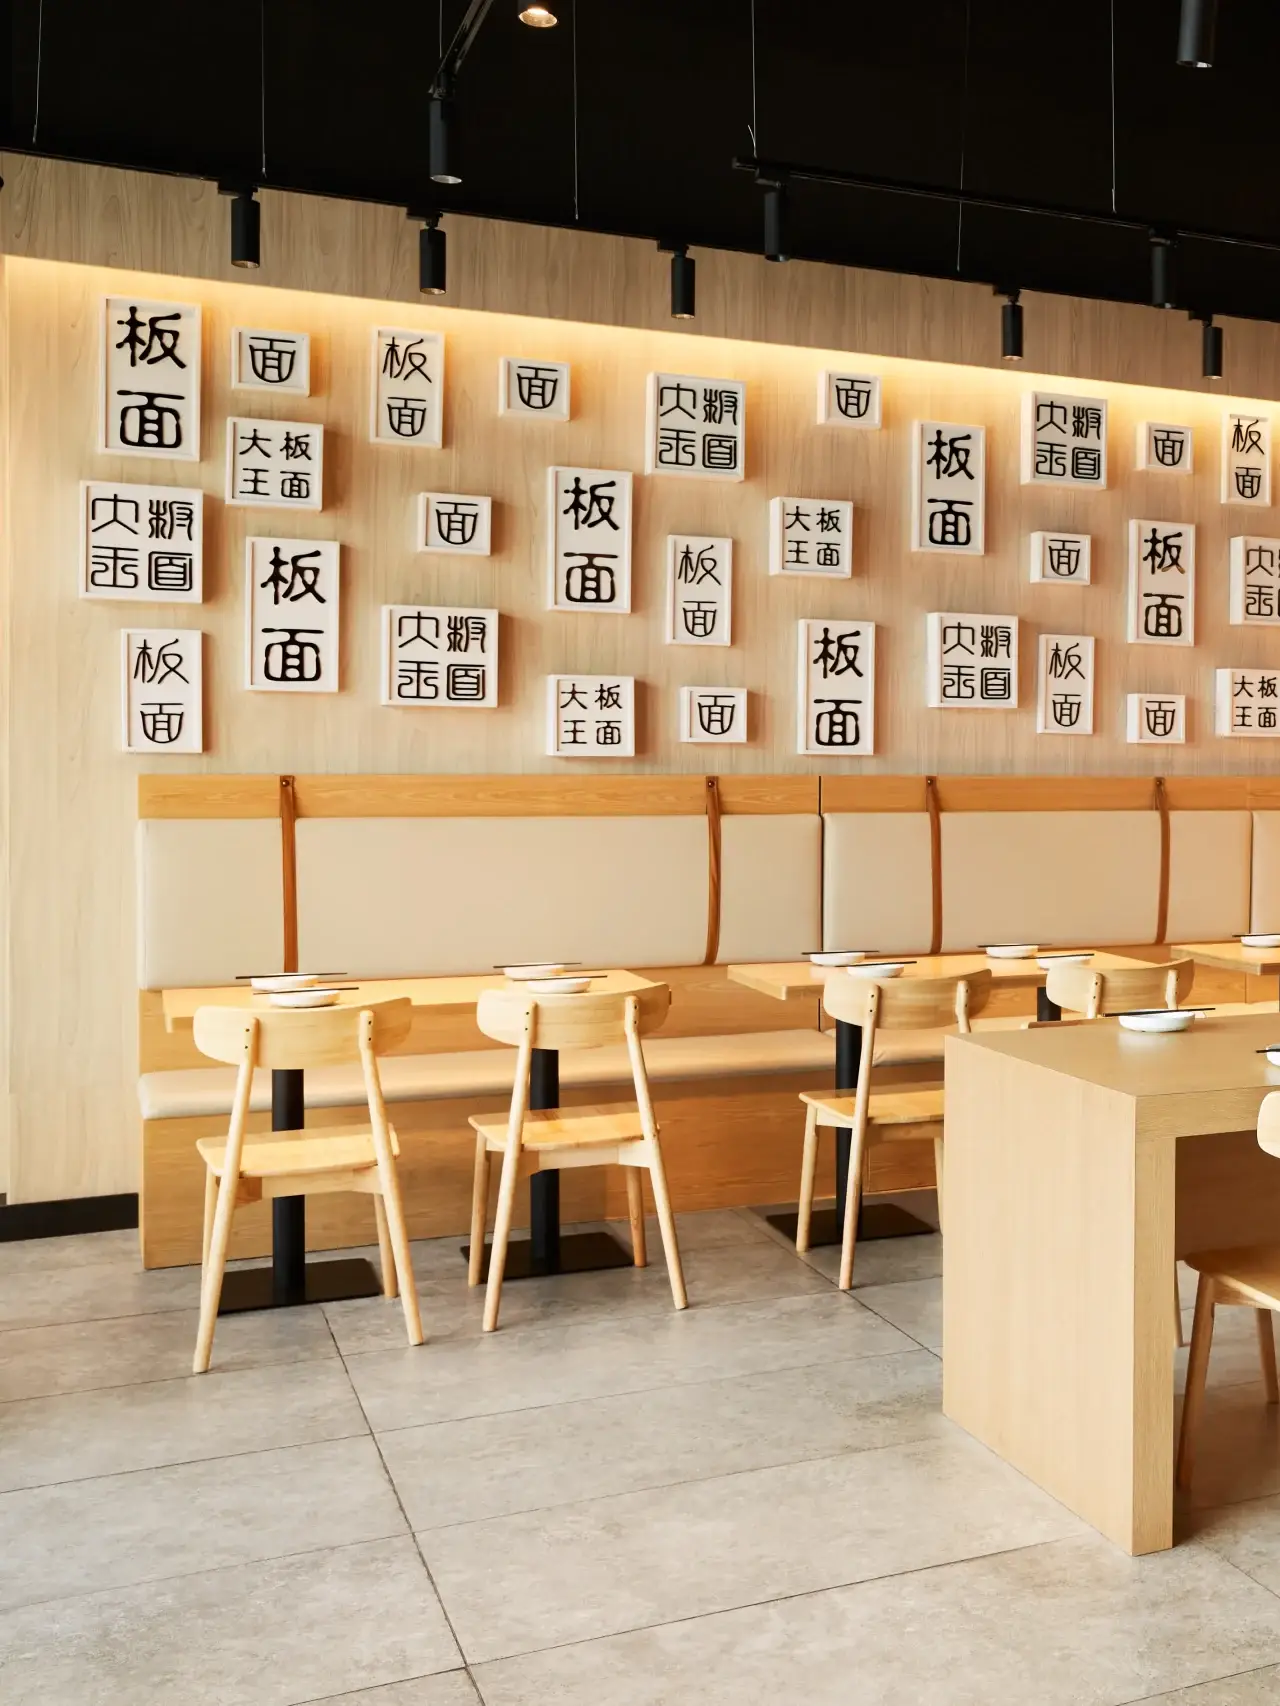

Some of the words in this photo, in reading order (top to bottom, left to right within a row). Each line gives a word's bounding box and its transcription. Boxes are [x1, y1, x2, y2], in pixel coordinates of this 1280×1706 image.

[116, 306, 186, 448] 板面
[249, 337, 296, 383] 面
[383, 337, 431, 437] 板面
[517, 366, 558, 409] 面
[836, 379, 871, 418] 面
[927, 430, 974, 545] 板面
[1154, 430, 1184, 466] 面
[1232, 419, 1264, 498] 板面
[436, 502, 478, 545] 面
[563, 477, 619, 603] 板面
[1048, 539, 1081, 577] 面
[261, 547, 326, 681] 板面
[678, 545, 721, 637] 板面
[1143, 528, 1184, 637] 板面
[134, 639, 188, 743] 板面
[698, 695, 735, 735] 面
[813, 628, 863, 746] 板面
[1049, 643, 1085, 727] 板面
[1146, 701, 1175, 736] 面
